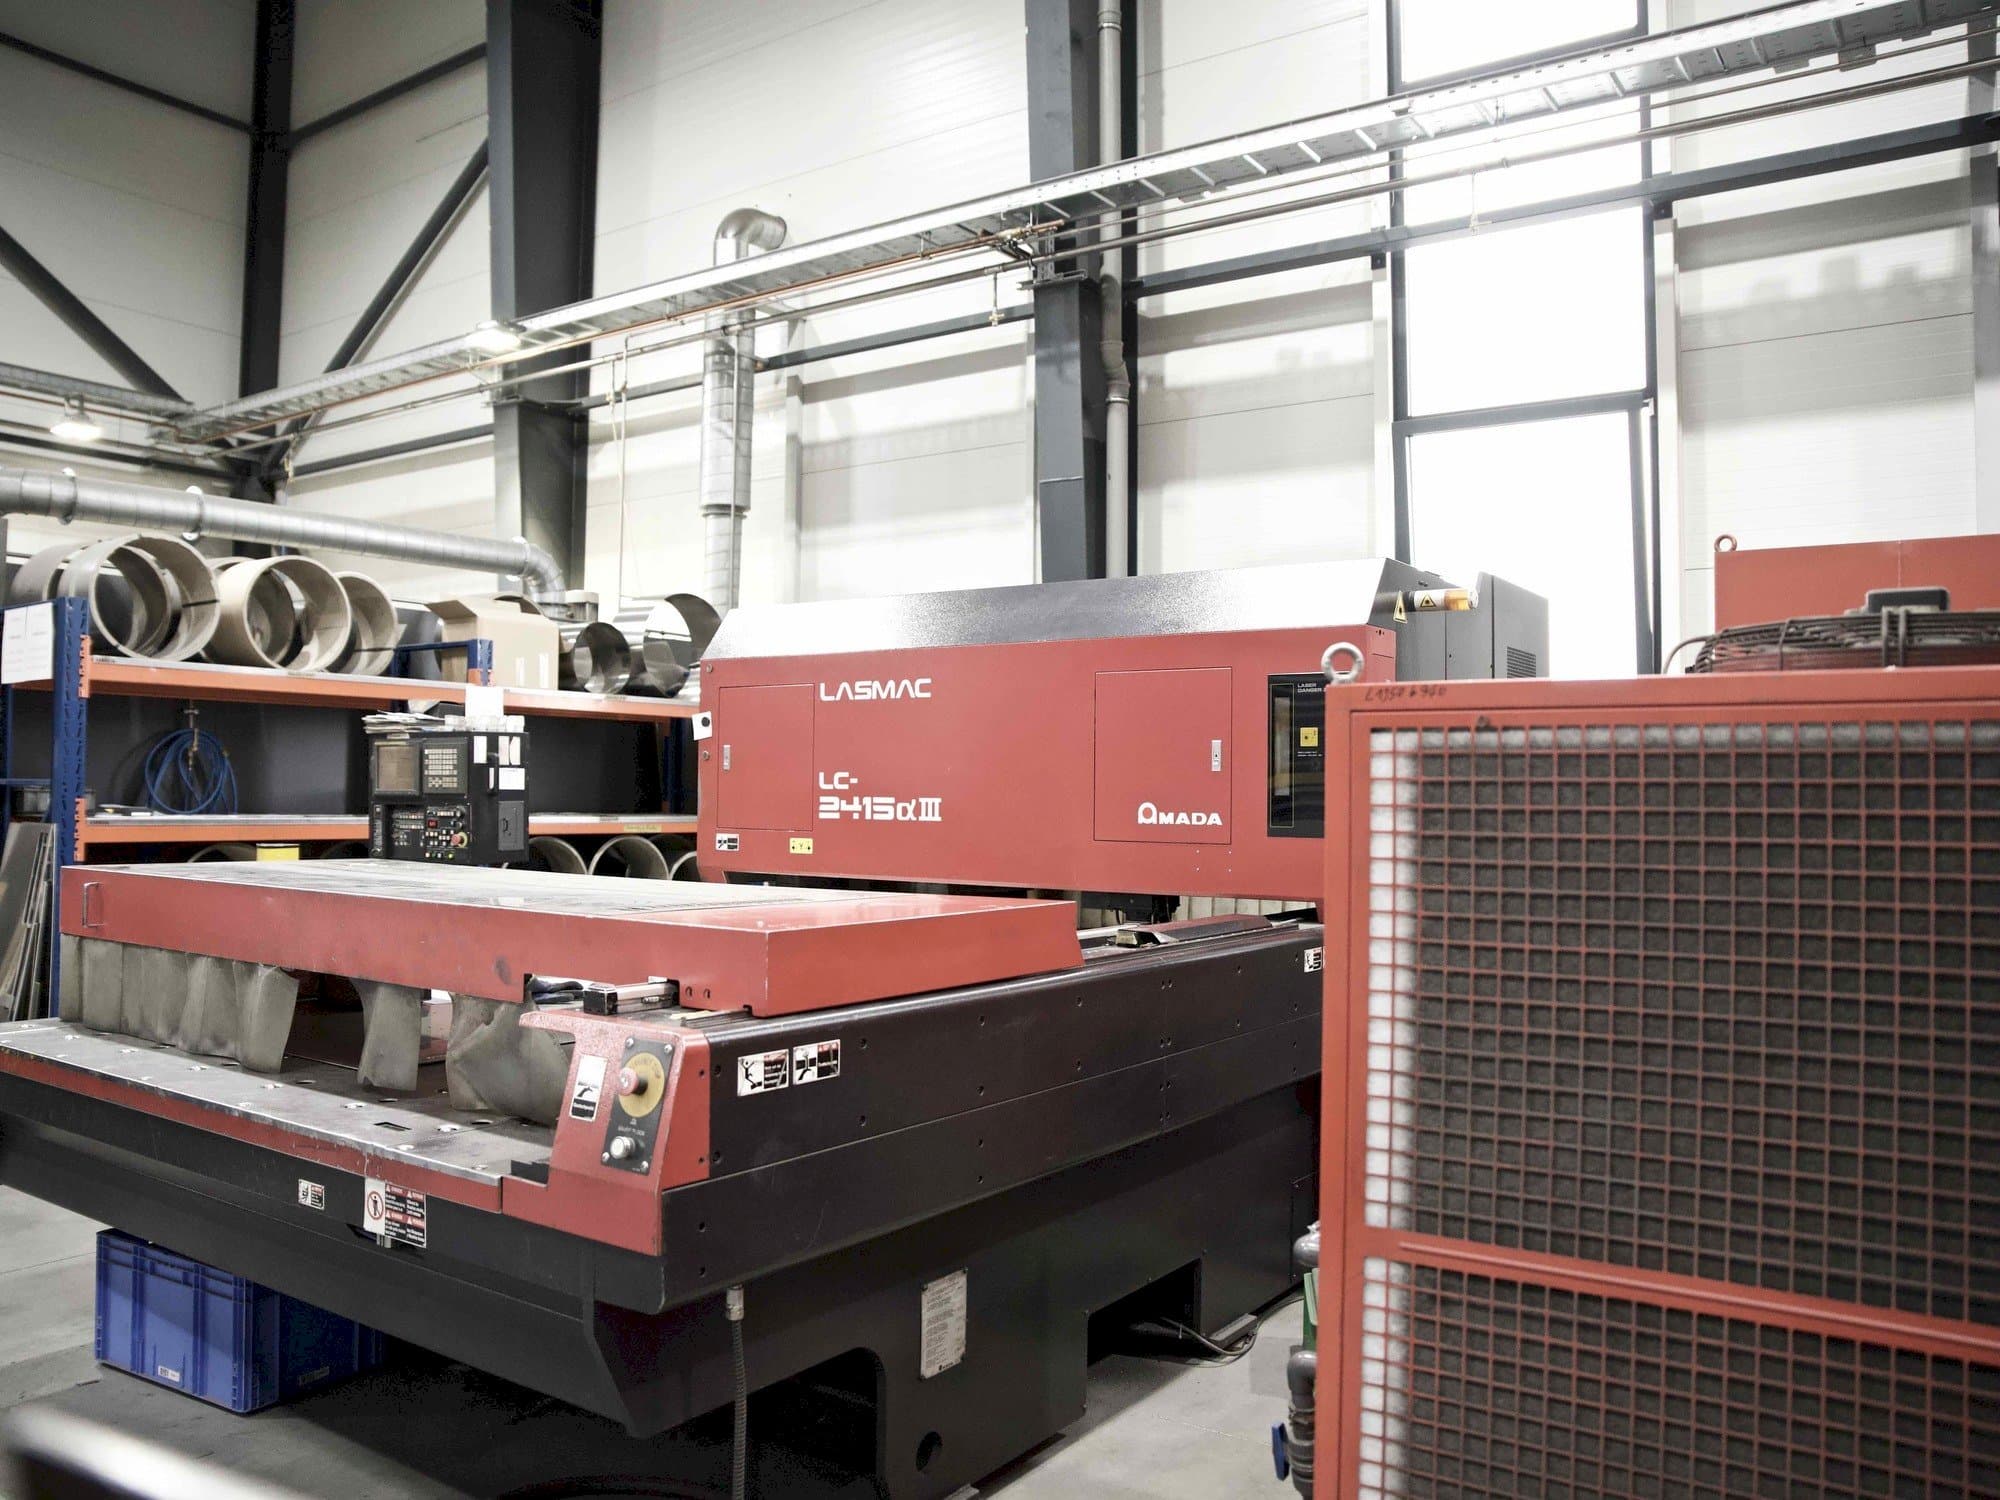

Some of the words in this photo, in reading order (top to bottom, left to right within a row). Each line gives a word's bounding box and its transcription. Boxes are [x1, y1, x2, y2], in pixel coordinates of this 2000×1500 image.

[819, 678, 932, 701] LASMAC
[818, 771, 859, 789] LC-
[1137, 802, 1223, 825] AMADA
